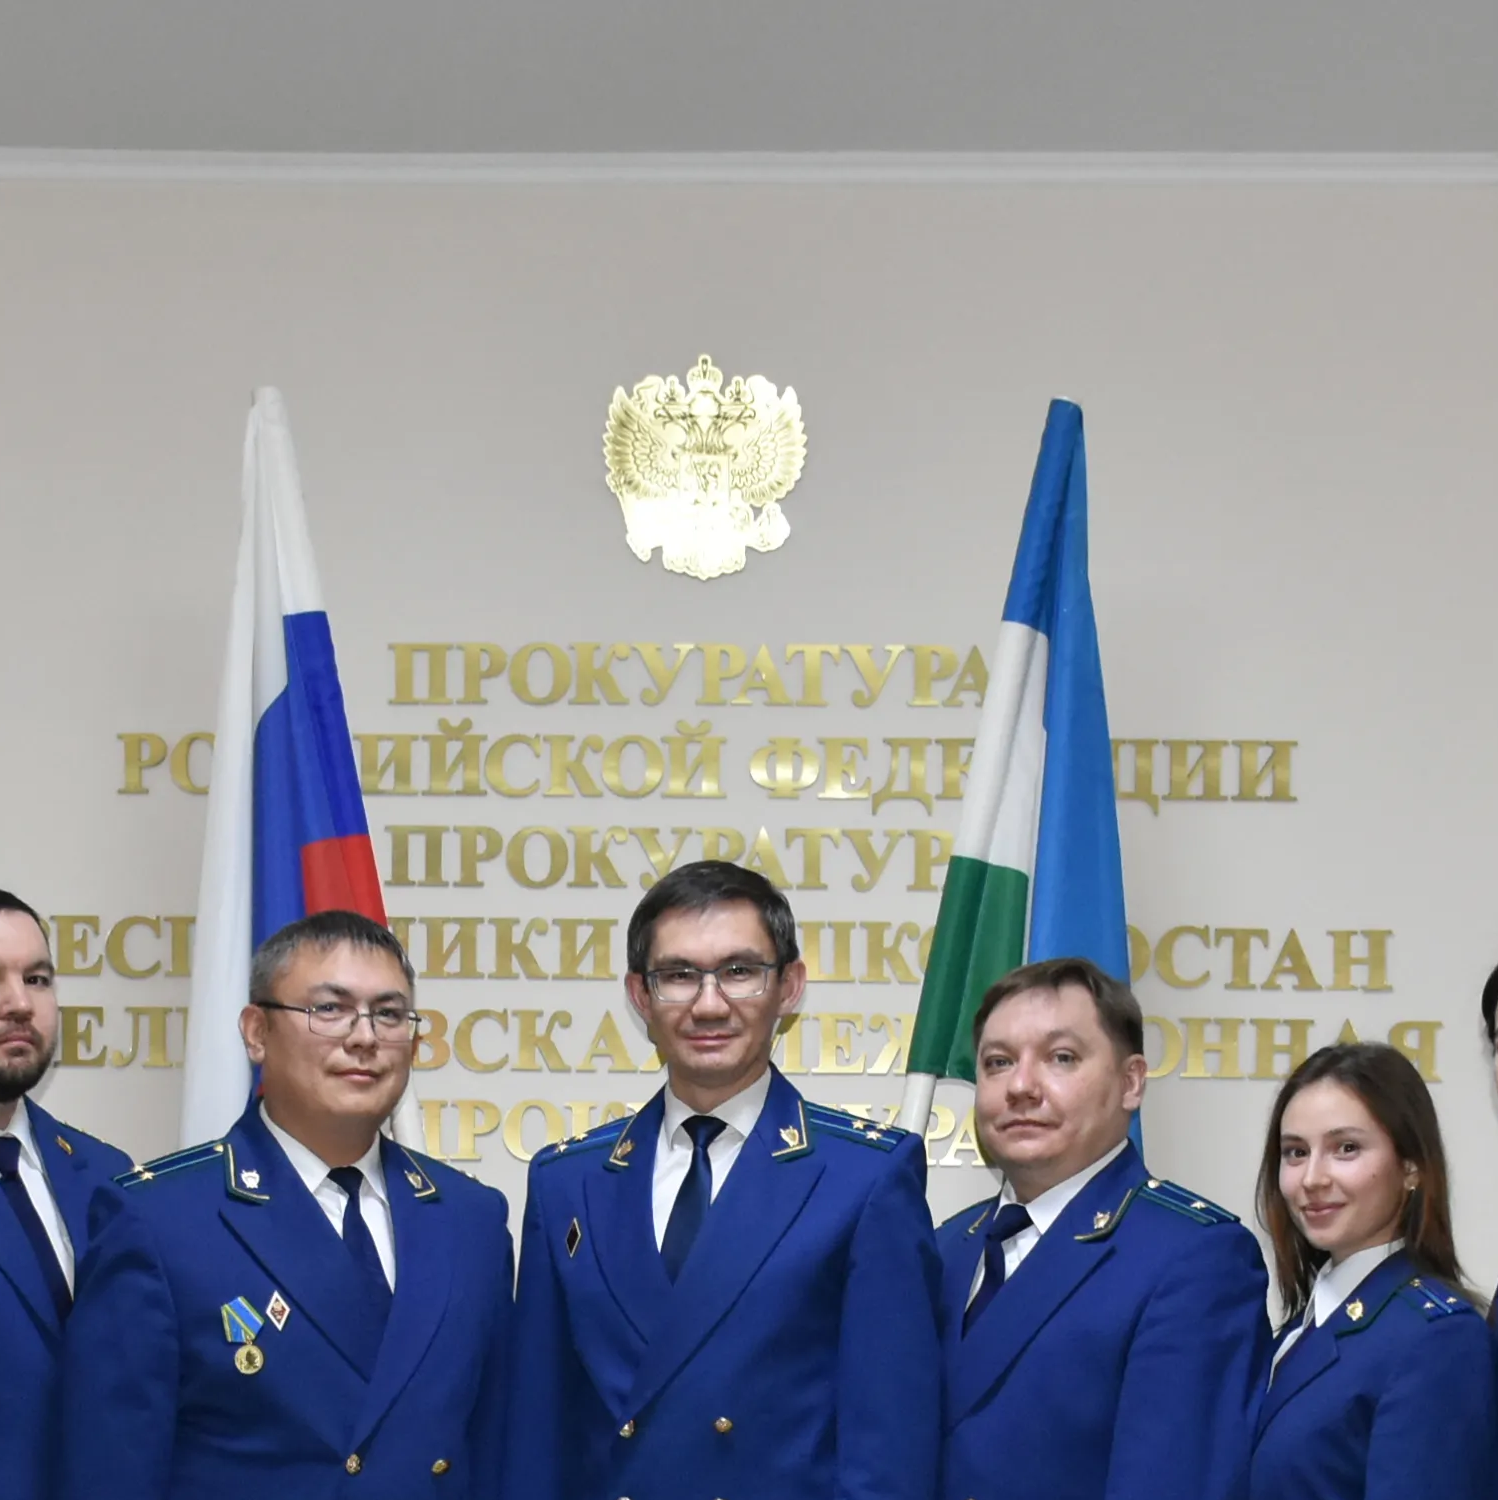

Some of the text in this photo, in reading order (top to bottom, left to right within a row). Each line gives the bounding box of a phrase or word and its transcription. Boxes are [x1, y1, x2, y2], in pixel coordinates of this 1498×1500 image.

[387, 641, 990, 708] ПРОКУРАТУРА
[116, 717, 1298, 817] РОИЙСКОЙ ФЕДЕЦИИ
[384, 824, 954, 892] ПРОКУРАТУР
